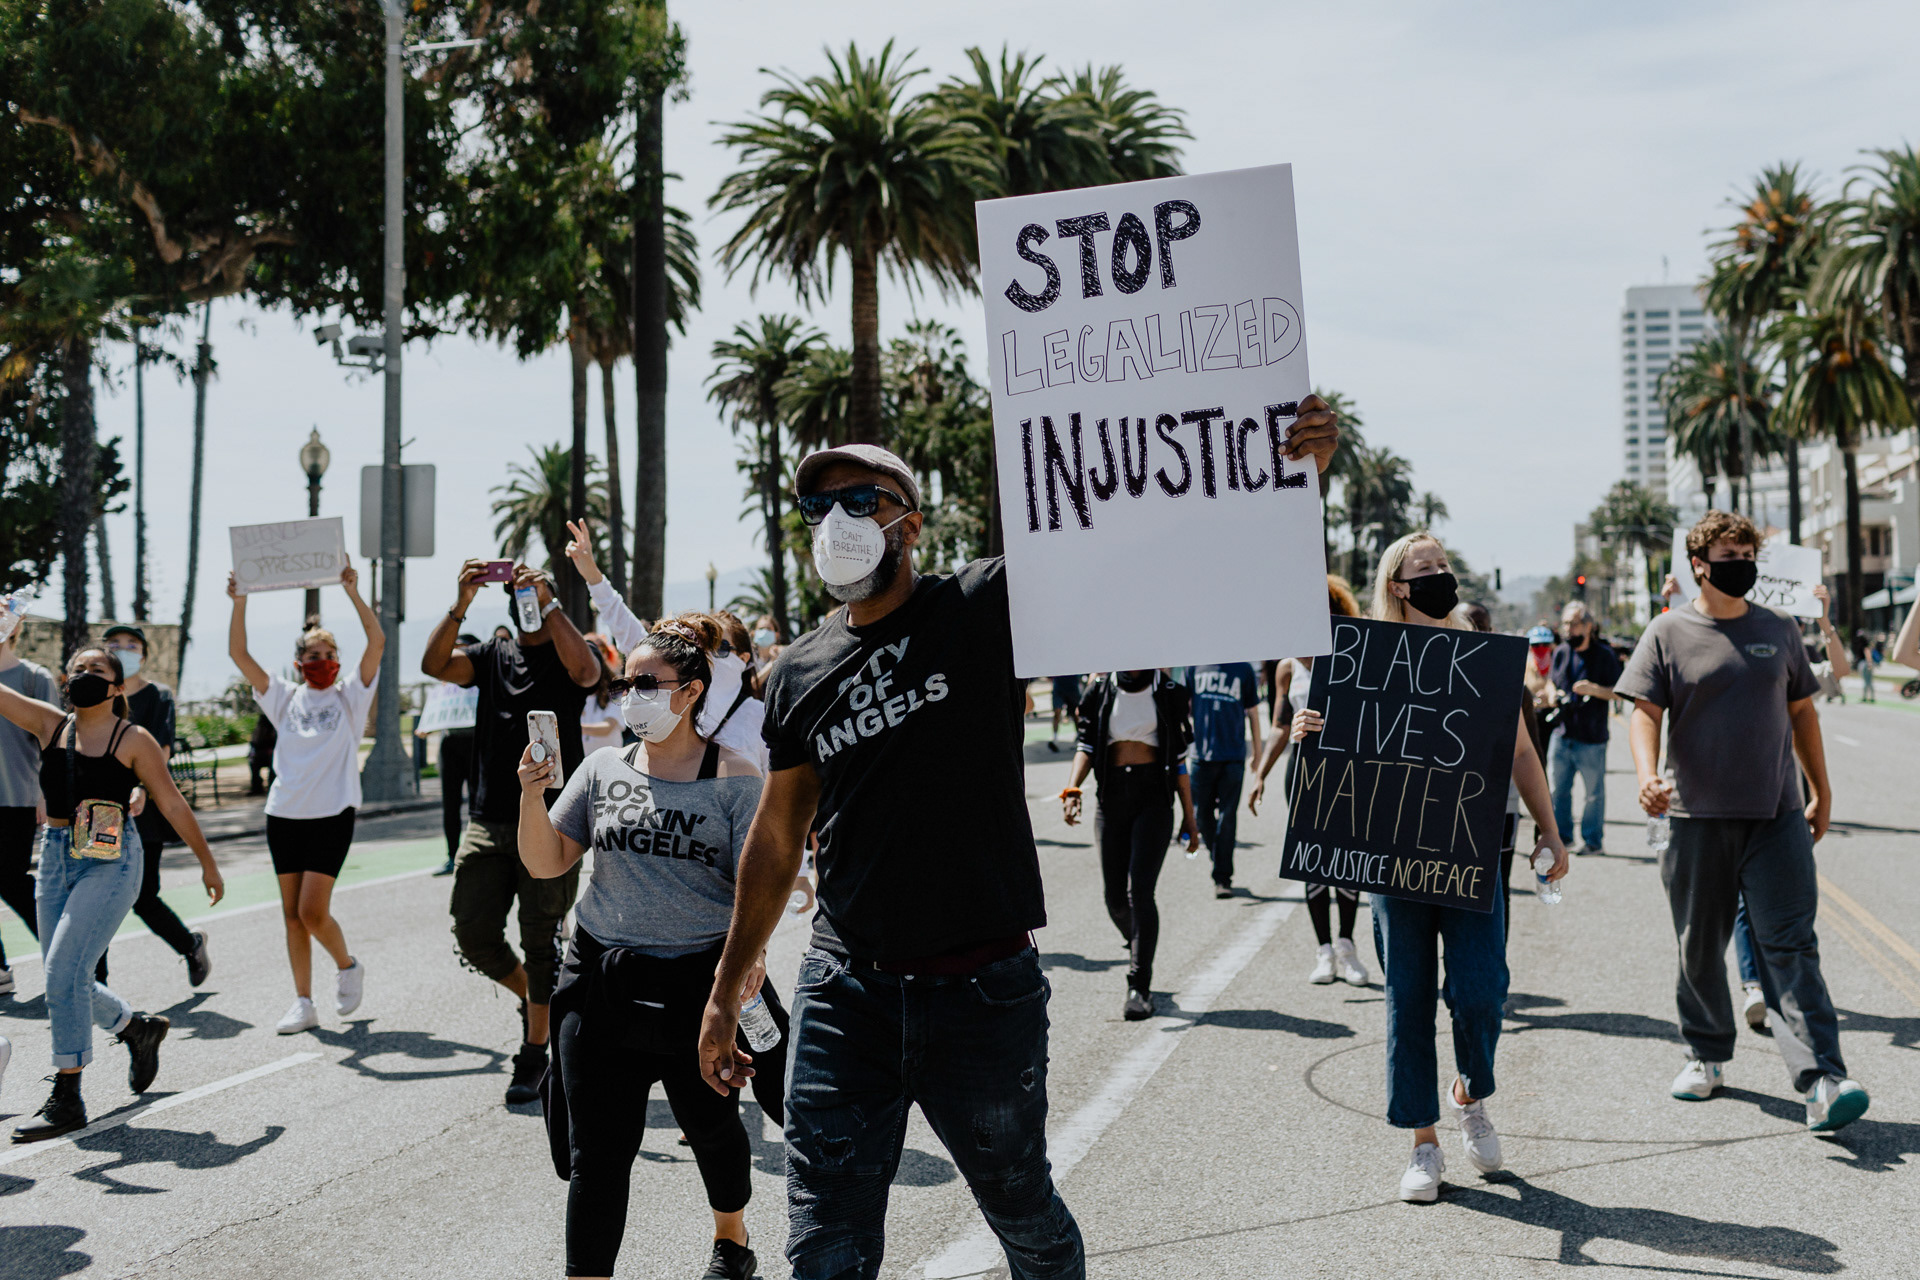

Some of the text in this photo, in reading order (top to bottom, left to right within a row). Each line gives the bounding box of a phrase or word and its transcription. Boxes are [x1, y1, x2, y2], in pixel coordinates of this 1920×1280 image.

[1004, 200, 1201, 313] STOP
[1002, 297, 1302, 396] LEGALIZED
[1020, 401, 1308, 533] INJUSTICE
[239, 551, 336, 583] OPPRESSION
[1756, 574, 1802, 591] eorge
[850, 670, 893, 711] OF
[1194, 671, 1241, 700] UCLA
[1329, 624, 1488, 698] BLACK
[815, 673, 949, 763] ANGELS
[1318, 696, 1469, 767] LIVES
[596, 780, 652, 804] LOS
[1291, 756, 1485, 858] MATTER
[596, 827, 719, 867] ANGELES
[1290, 841, 1321, 873] NO
[1321, 847, 1389, 885] JUSTICE
[1424, 860, 1483, 900] PEACE
